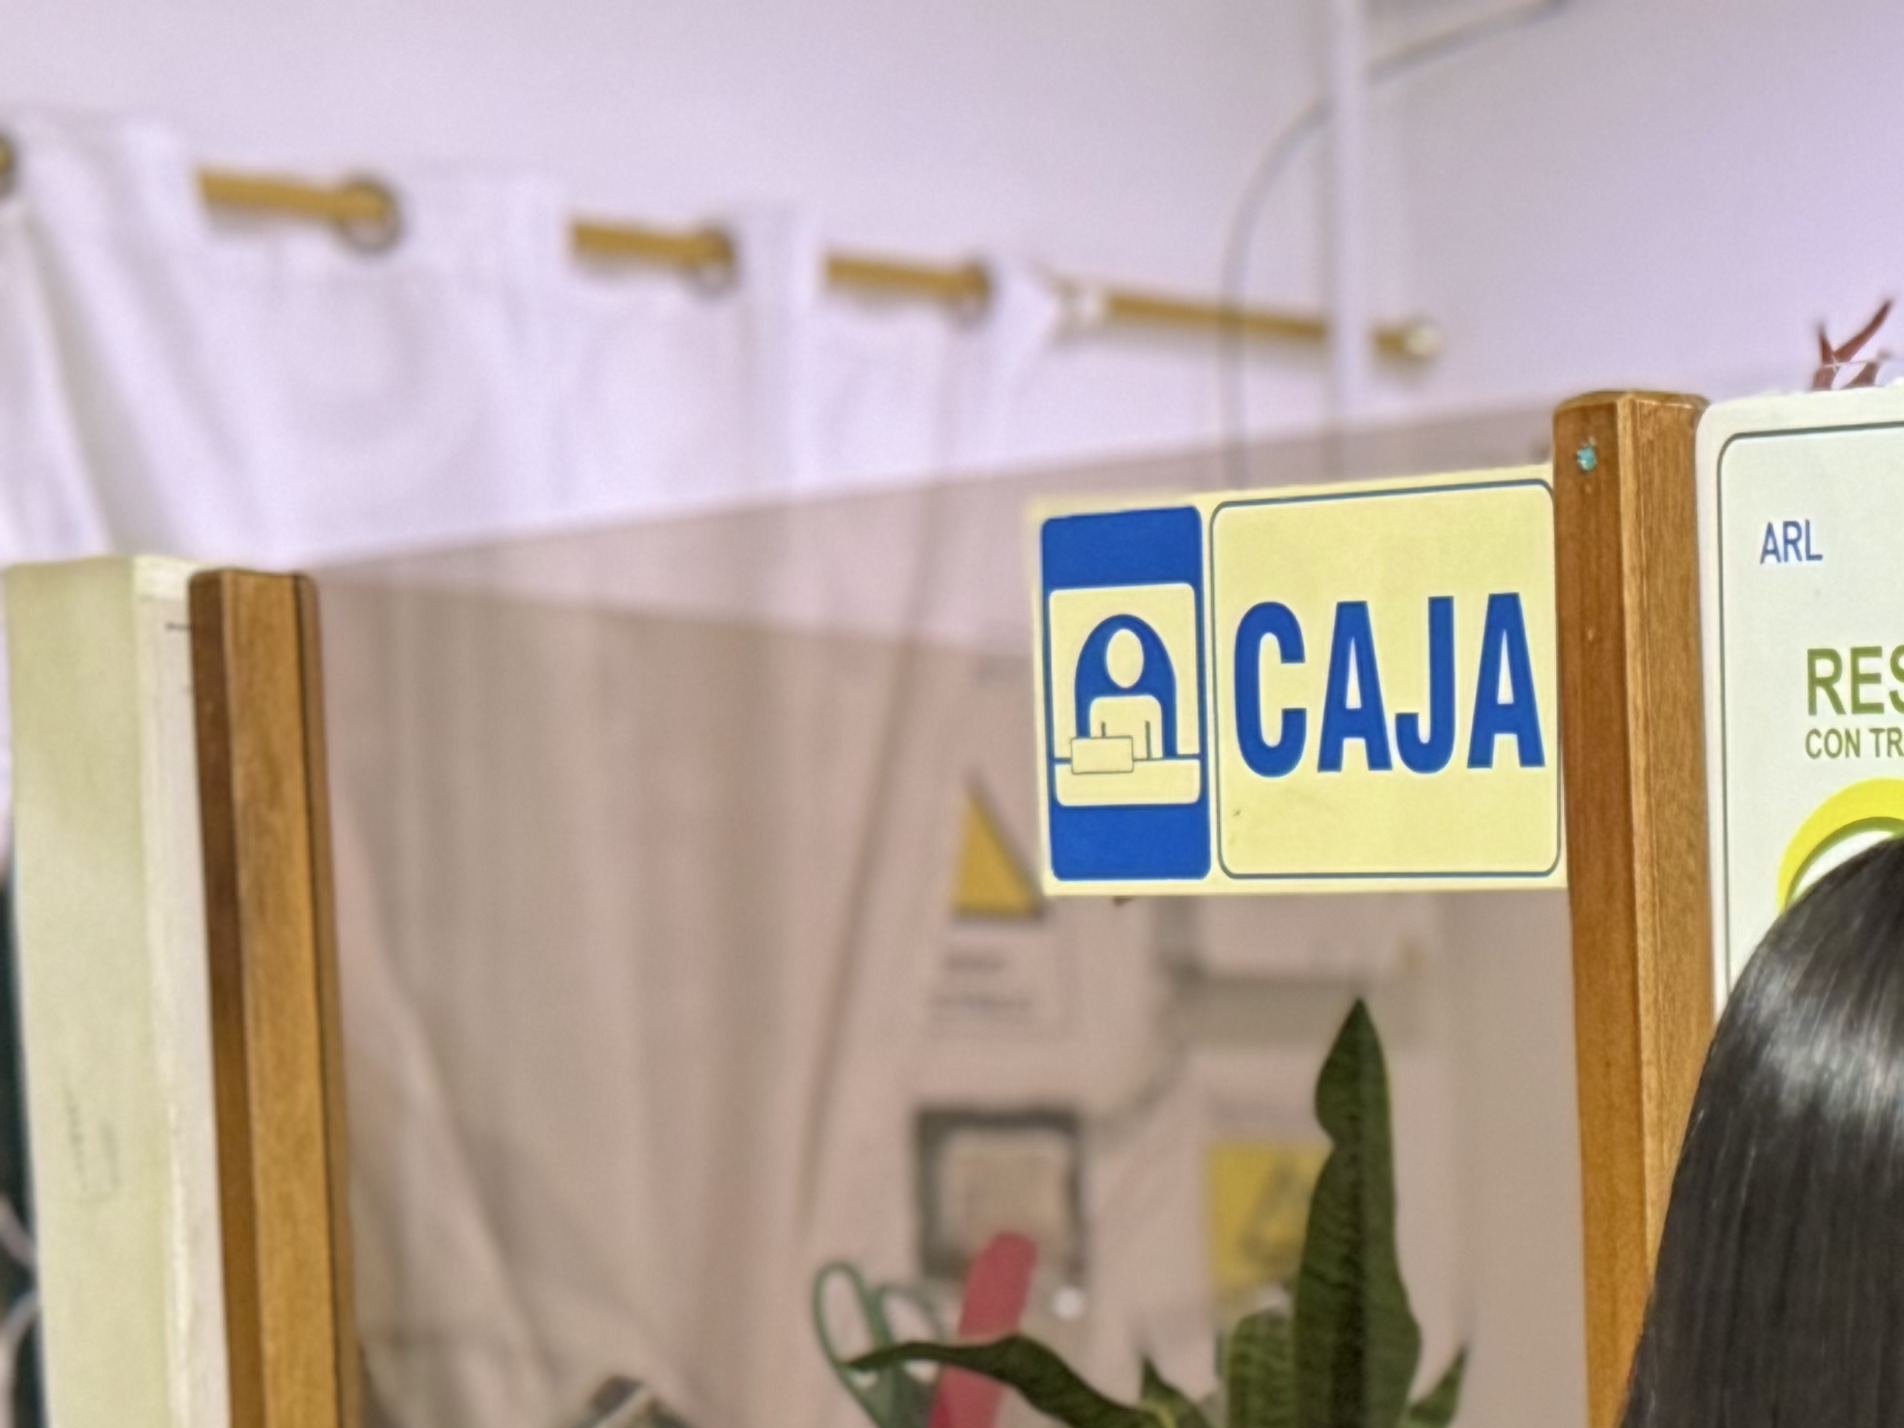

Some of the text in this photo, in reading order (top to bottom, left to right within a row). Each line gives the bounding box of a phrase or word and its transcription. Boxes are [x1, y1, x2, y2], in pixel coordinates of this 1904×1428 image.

[1759, 519, 1824, 565] ARL
[1233, 592, 1546, 779] CAJA
[1805, 728, 1861, 759] CON
